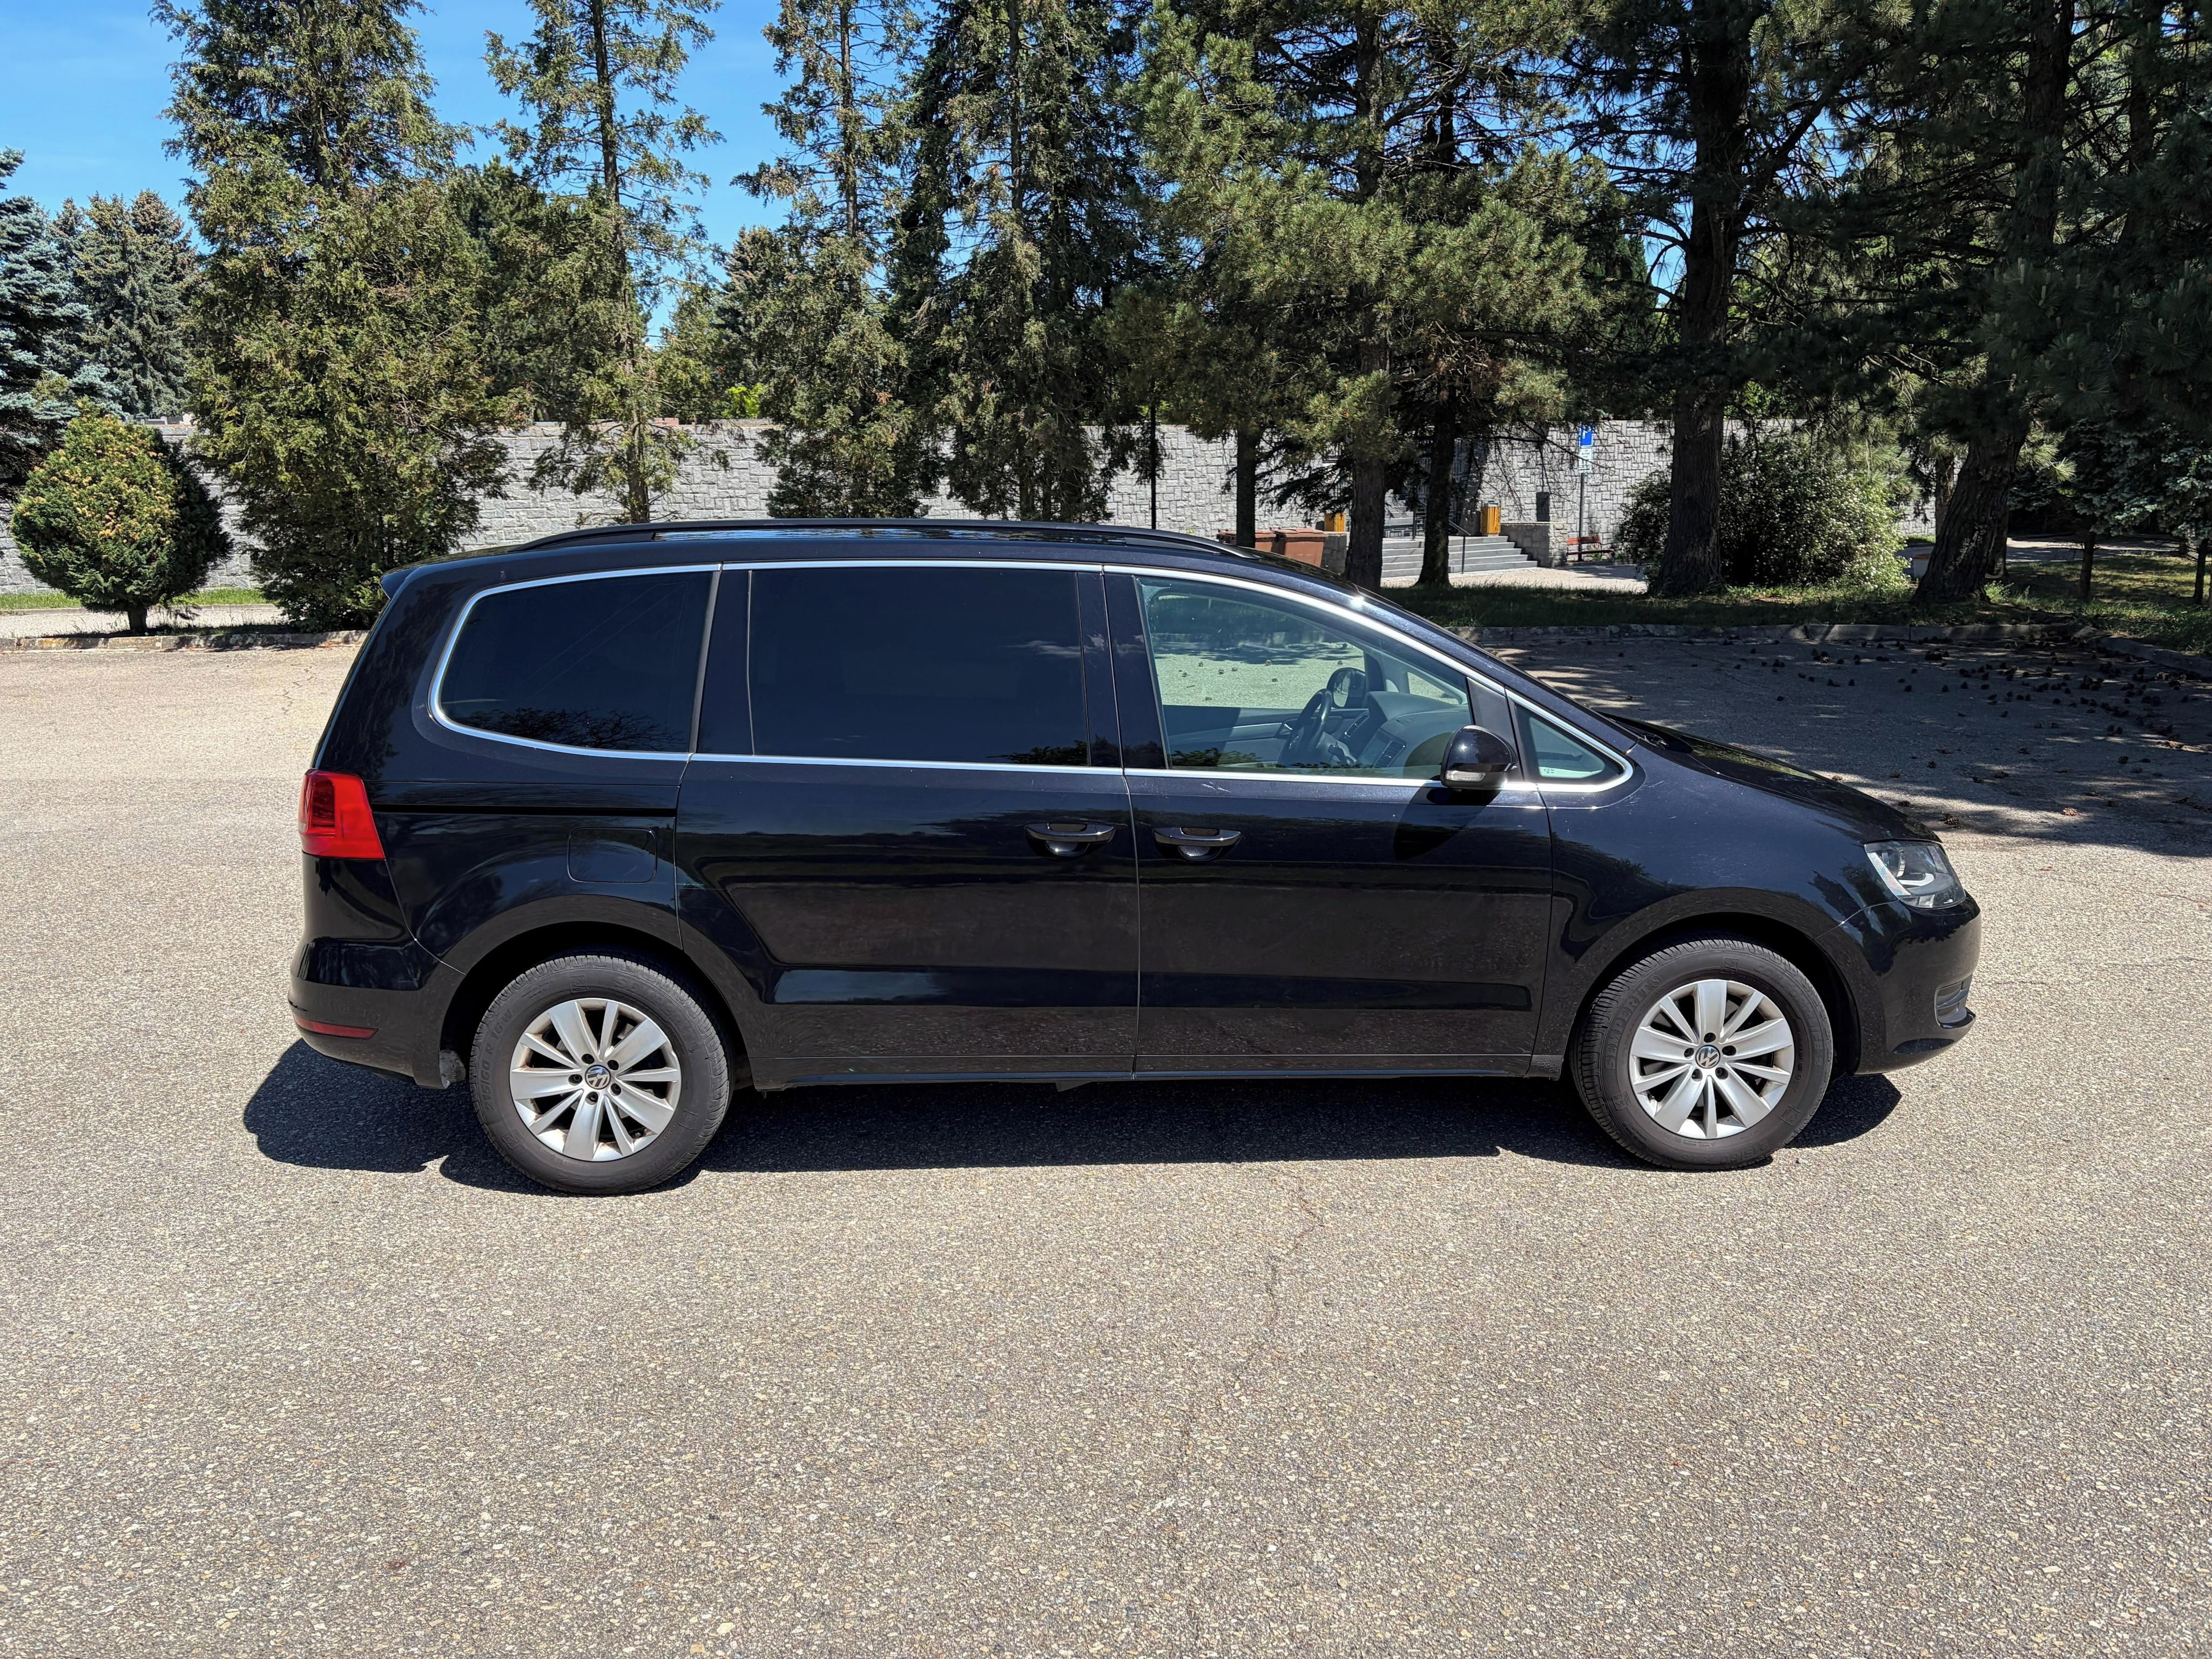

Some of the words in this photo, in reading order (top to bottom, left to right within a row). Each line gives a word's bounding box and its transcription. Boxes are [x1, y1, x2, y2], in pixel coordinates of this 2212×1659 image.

[491, 1022, 504, 1040] 16
[1604, 983, 1649, 1070] SEMPERIT
[485, 1042, 495, 1055] R
[480, 1059, 495, 1111] 215/60
